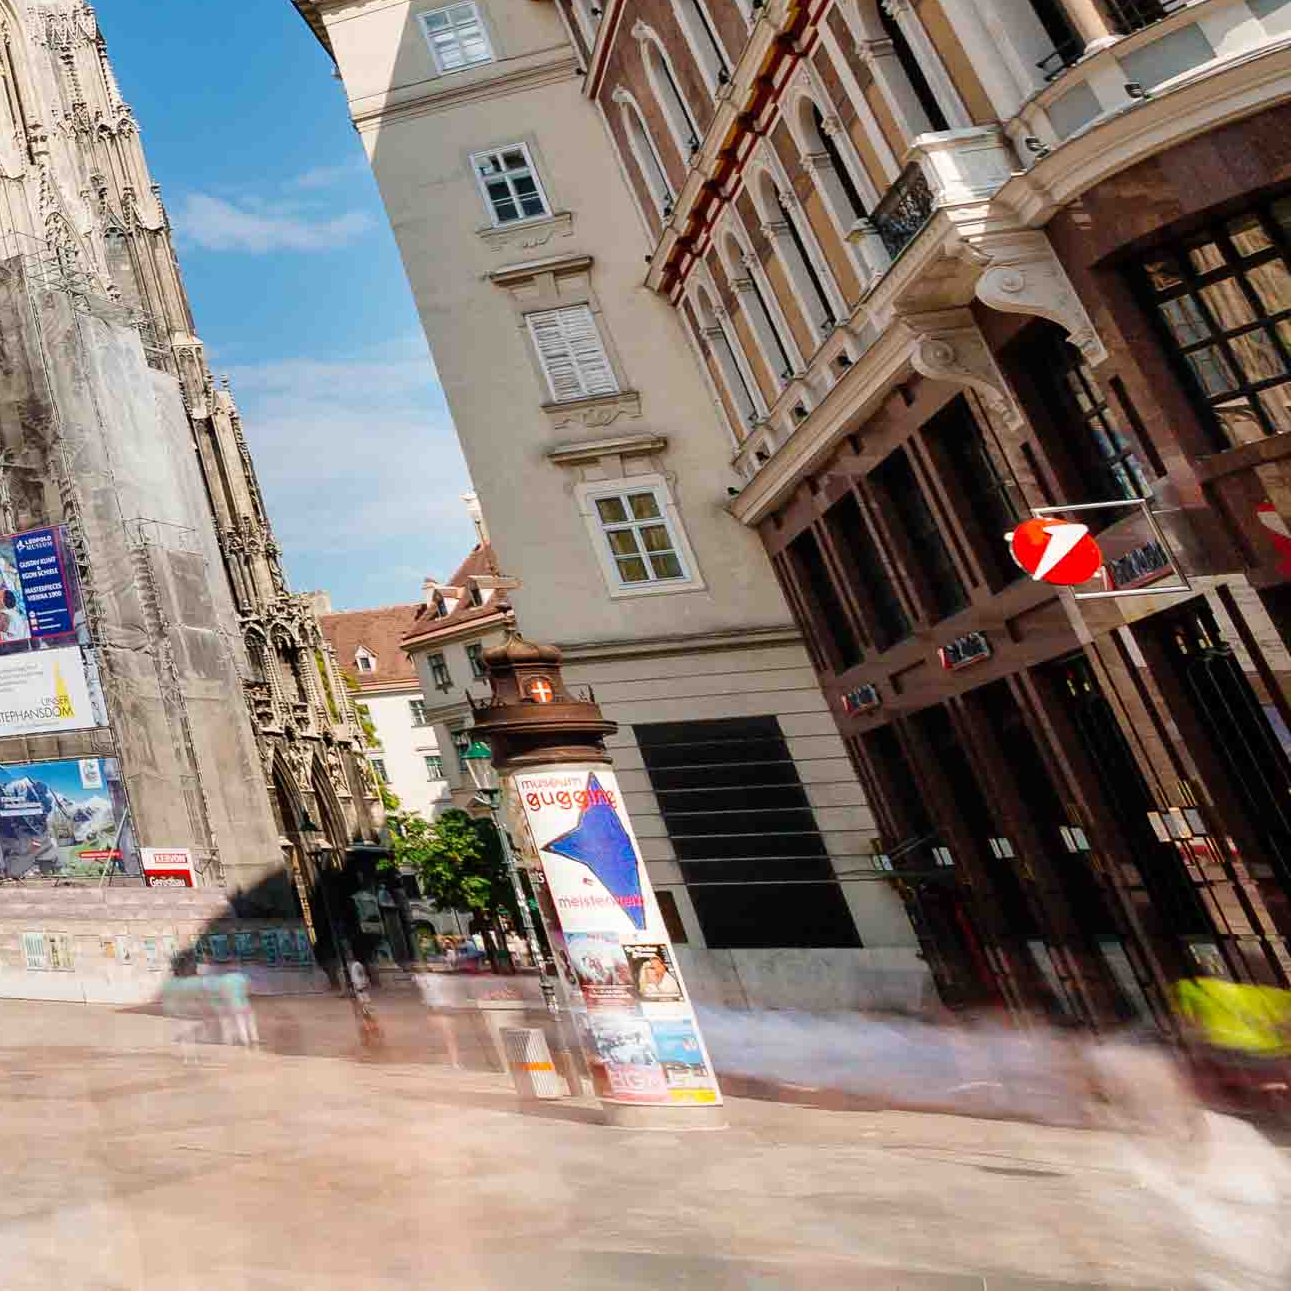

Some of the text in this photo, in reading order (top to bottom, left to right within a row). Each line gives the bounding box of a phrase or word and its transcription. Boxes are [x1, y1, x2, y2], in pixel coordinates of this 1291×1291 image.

[26, 542, 53, 551] MUSEUM
[42, 695, 69, 707] UNSER
[526, 790, 619, 812] gugging
